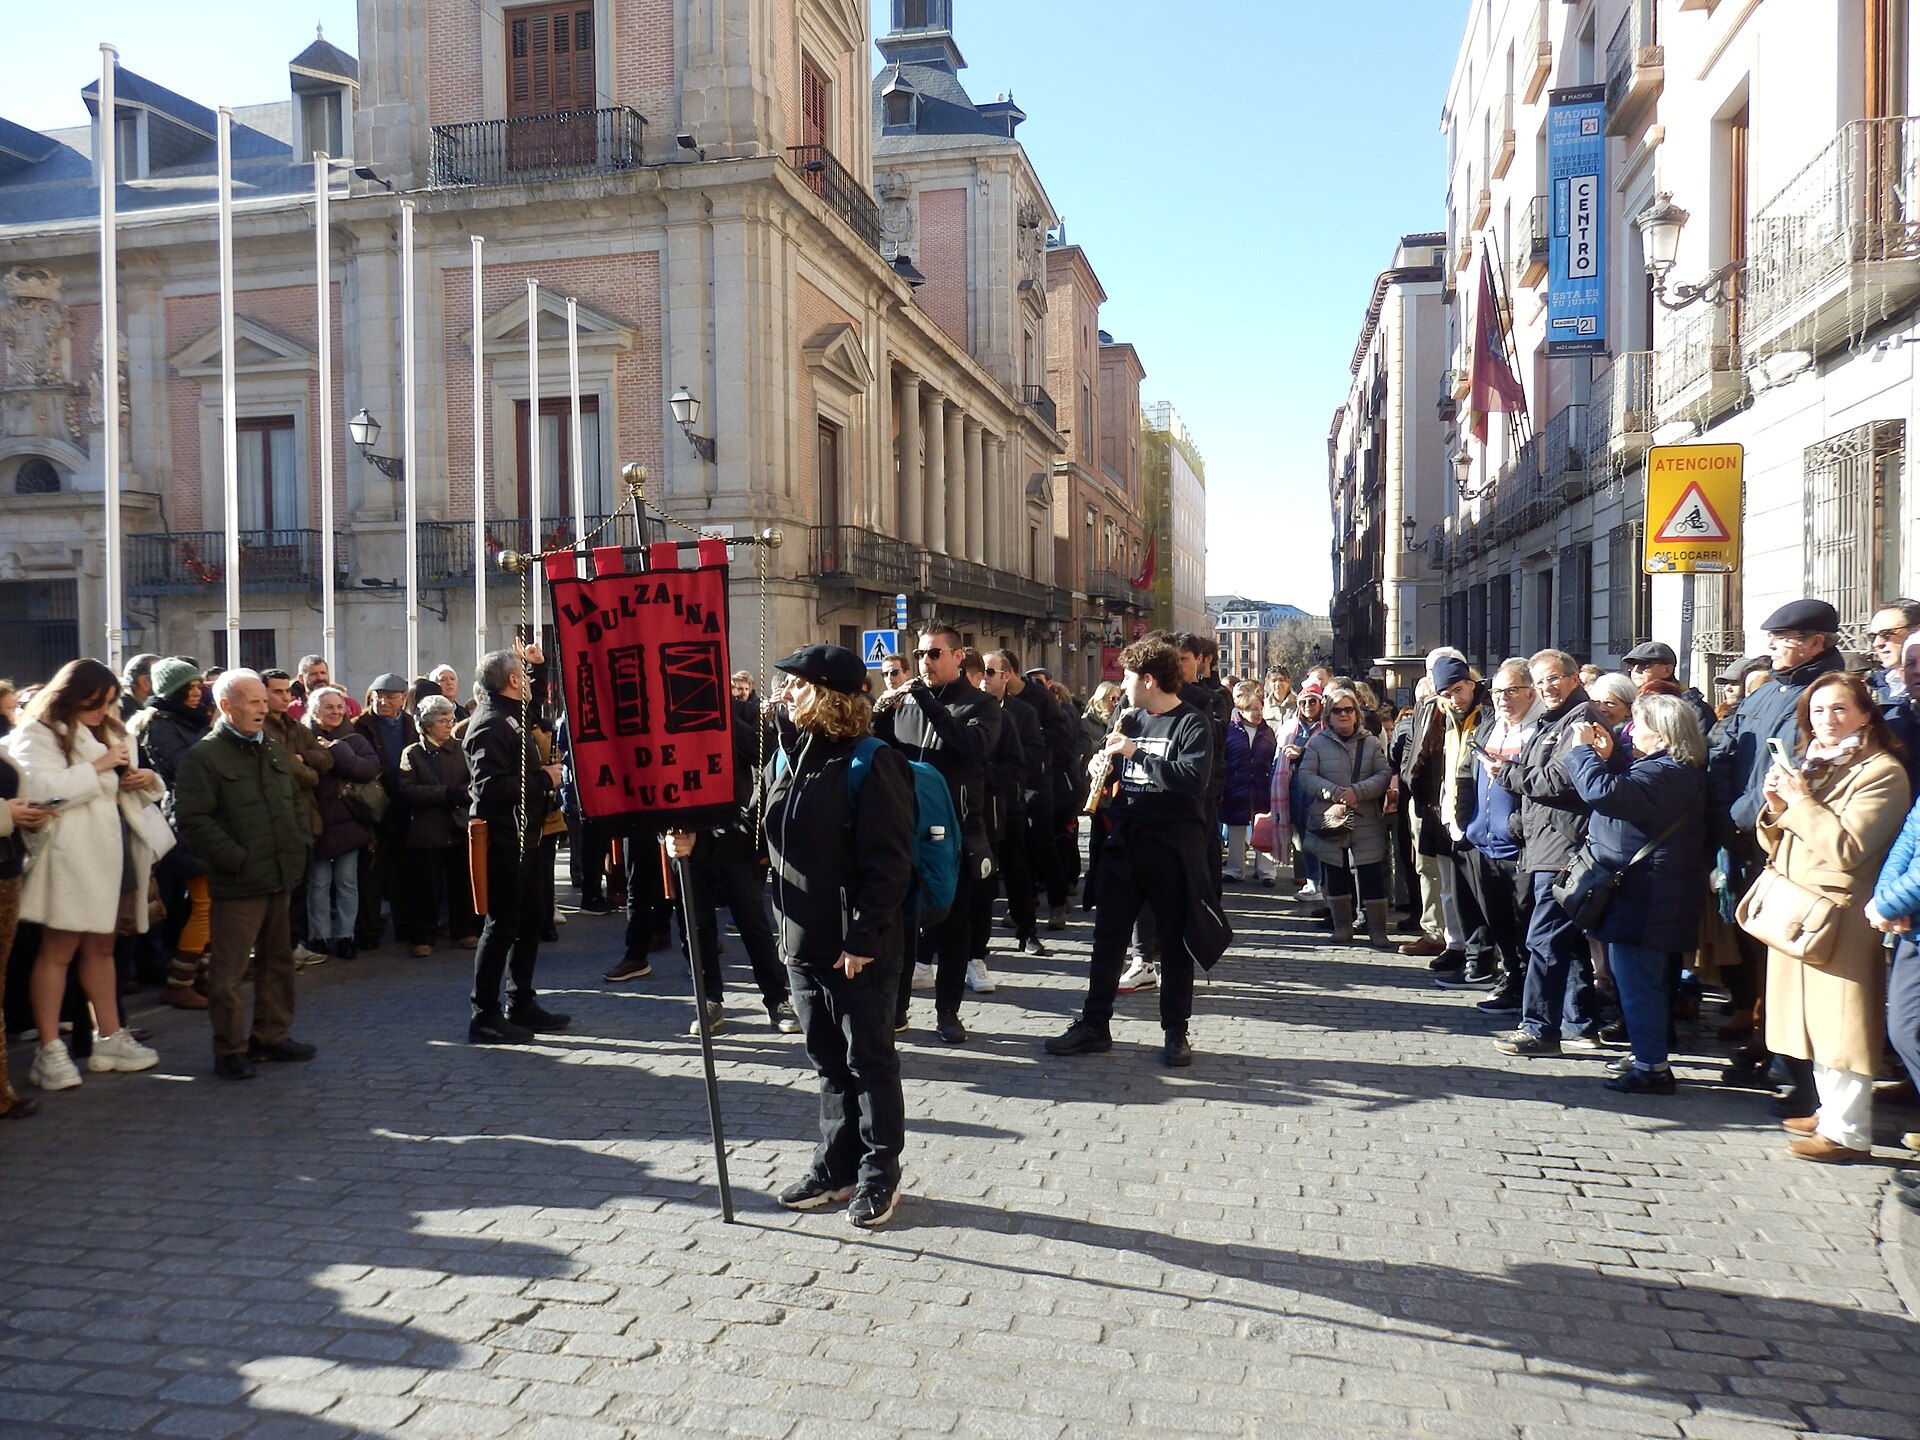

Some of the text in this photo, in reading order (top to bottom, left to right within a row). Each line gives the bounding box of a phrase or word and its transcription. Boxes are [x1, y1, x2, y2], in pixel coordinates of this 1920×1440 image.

[1554, 108, 1600, 120] MADRID
[1554, 118, 1596, 132] TIENE 21
[1565, 136, 1600, 144] DISTRITO
[1562, 154, 1586, 162] VIVES
[1573, 159, 1599, 168] BARRIO
[1554, 165, 1600, 177] ERES DEL
[1576, 184, 1590, 270] CENTRO
[1552, 288, 1599, 300] ESTA ES
[1568, 298, 1598, 308] JUNTA
[1580, 319, 1594, 332] 21
[1655, 456, 1737, 472] ATENCION
[562, 582, 720, 643] LA DULZAINA
[635, 744, 676, 768] DE
[596, 753, 722, 806] ALUCHE
